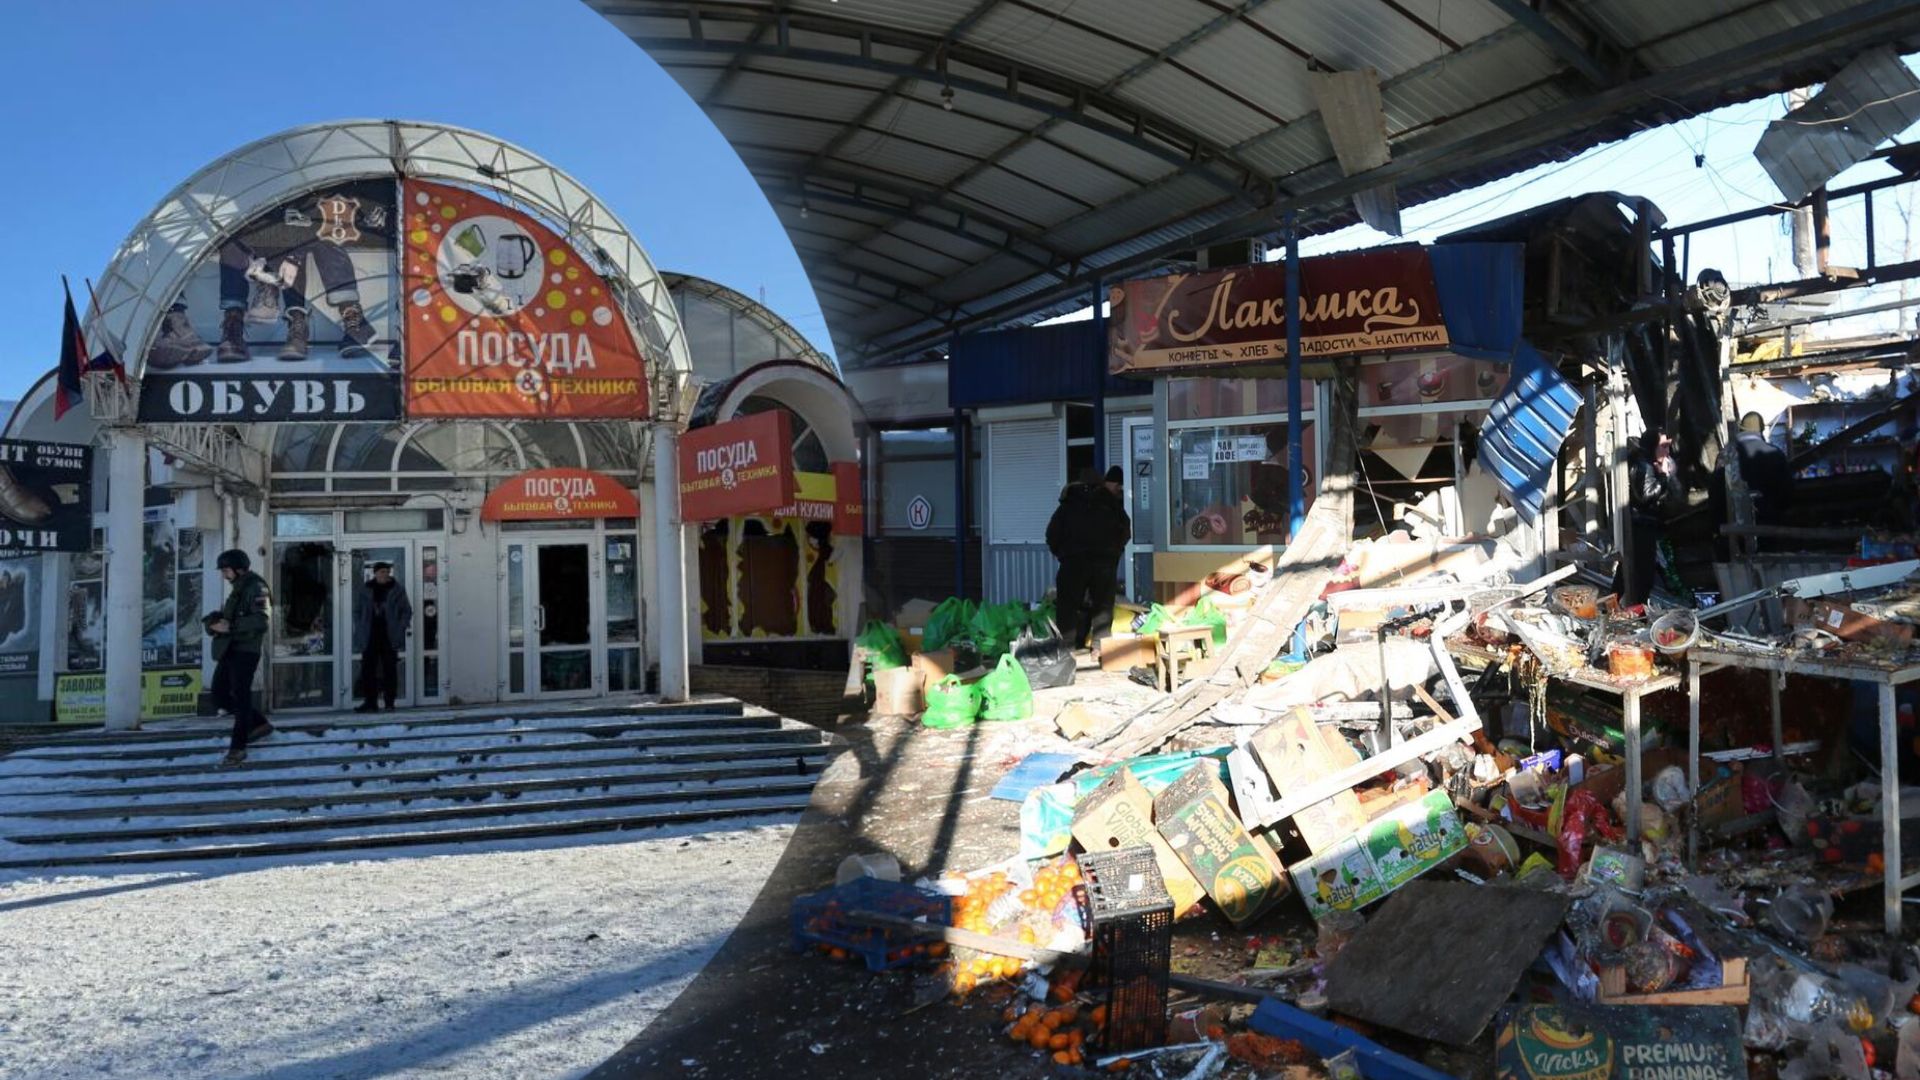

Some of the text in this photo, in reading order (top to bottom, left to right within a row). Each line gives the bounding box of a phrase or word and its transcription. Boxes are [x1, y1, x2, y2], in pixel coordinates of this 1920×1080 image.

[457, 330, 596, 374] ПОСУДА
[1168, 330, 1440, 362] КОНФЕТЫ ХЛЕБ ЛАДОСТИ НАПИТКИ
[169, 379, 366, 415] ОБУВЬ
[414, 378, 511, 394] БЫТОВАЯ
[552, 378, 638, 394] ТЕХНИКА
[697, 440, 758, 473] ПОСУДА
[1215, 451, 1236, 460] КОФЕ
[525, 478, 596, 498] ПОСУДА
[681, 475, 722, 493] БЫТОВАЯ
[736, 465, 779, 483] ТЕХНИКА
[504, 503, 553, 512] БЫТОВАЯ
[573, 501, 618, 511] ТЕХНИКА
[800, 501, 834, 519] КУХНИ
[1105, 812, 1138, 849] Villag
[1185, 814, 1229, 862] PREMIUM
[1195, 804, 1239, 852] BANANAS
[1534, 1049, 1599, 1074] Vicky
[1623, 1044, 1726, 1065] PREMIUM
